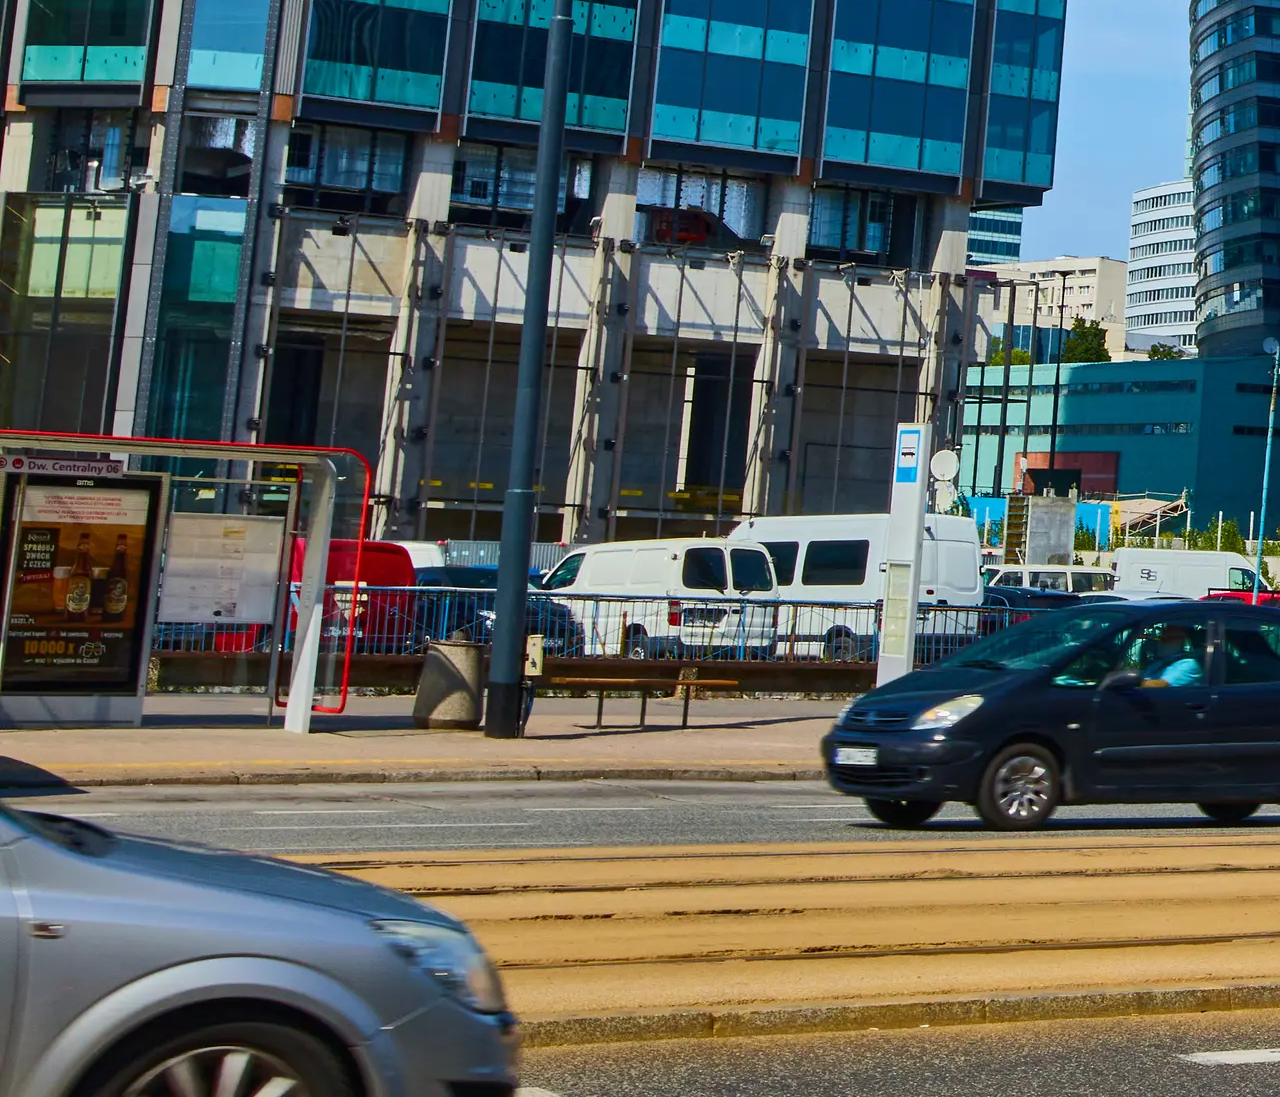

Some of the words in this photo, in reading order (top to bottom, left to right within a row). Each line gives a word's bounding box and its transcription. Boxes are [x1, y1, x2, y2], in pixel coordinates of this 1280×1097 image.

[28, 461, 49, 471] Dw.
[52, 462, 104, 475] Centralny
[106, 464, 120, 474] 06
